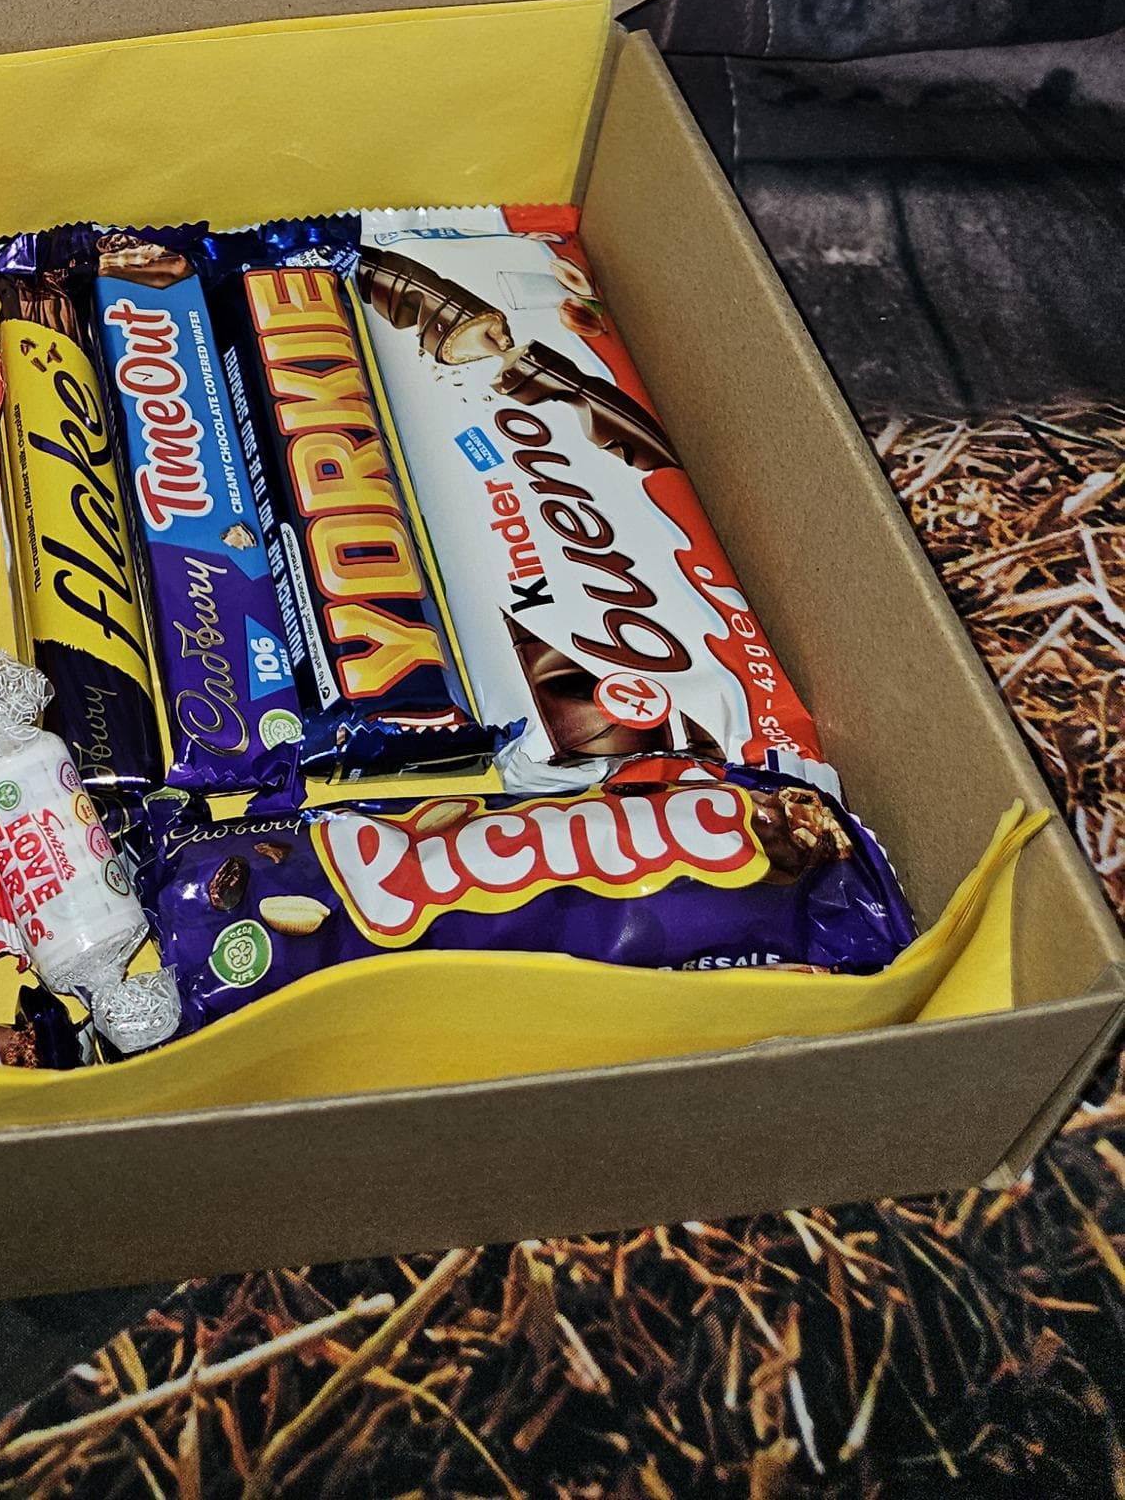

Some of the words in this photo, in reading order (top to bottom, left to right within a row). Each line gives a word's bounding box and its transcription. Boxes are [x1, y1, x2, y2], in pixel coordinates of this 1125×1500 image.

[188, 310, 205, 347] WAFER
[197, 346, 216, 396] COVERED
[224, 346, 249, 424] SEPARATELY
[106, 301, 211, 527] TimeOut
[208, 395, 233, 463] CHOCOLATE
[241, 420, 257, 459] SOLD
[222, 463, 244, 514] CREAMY
[245, 270, 450, 698] YORKIE
[249, 454, 262, 479] BE
[254, 478, 270, 501] TO
[28, 369, 148, 662] flake
[258, 498, 274, 534] NOT
[484, 479, 555, 613] Kinder
[494, 407, 693, 673] bueno
[268, 537, 285, 578] BAR
[276, 573, 305, 667] MULTIPACK
[174, 556, 252, 758] Cadbury
[250, 636, 283, 683] 106
[5, 814, 63, 907] LOVE
[328, 787, 743, 927] Picnic
[231, 970, 256, 984] LIFE
